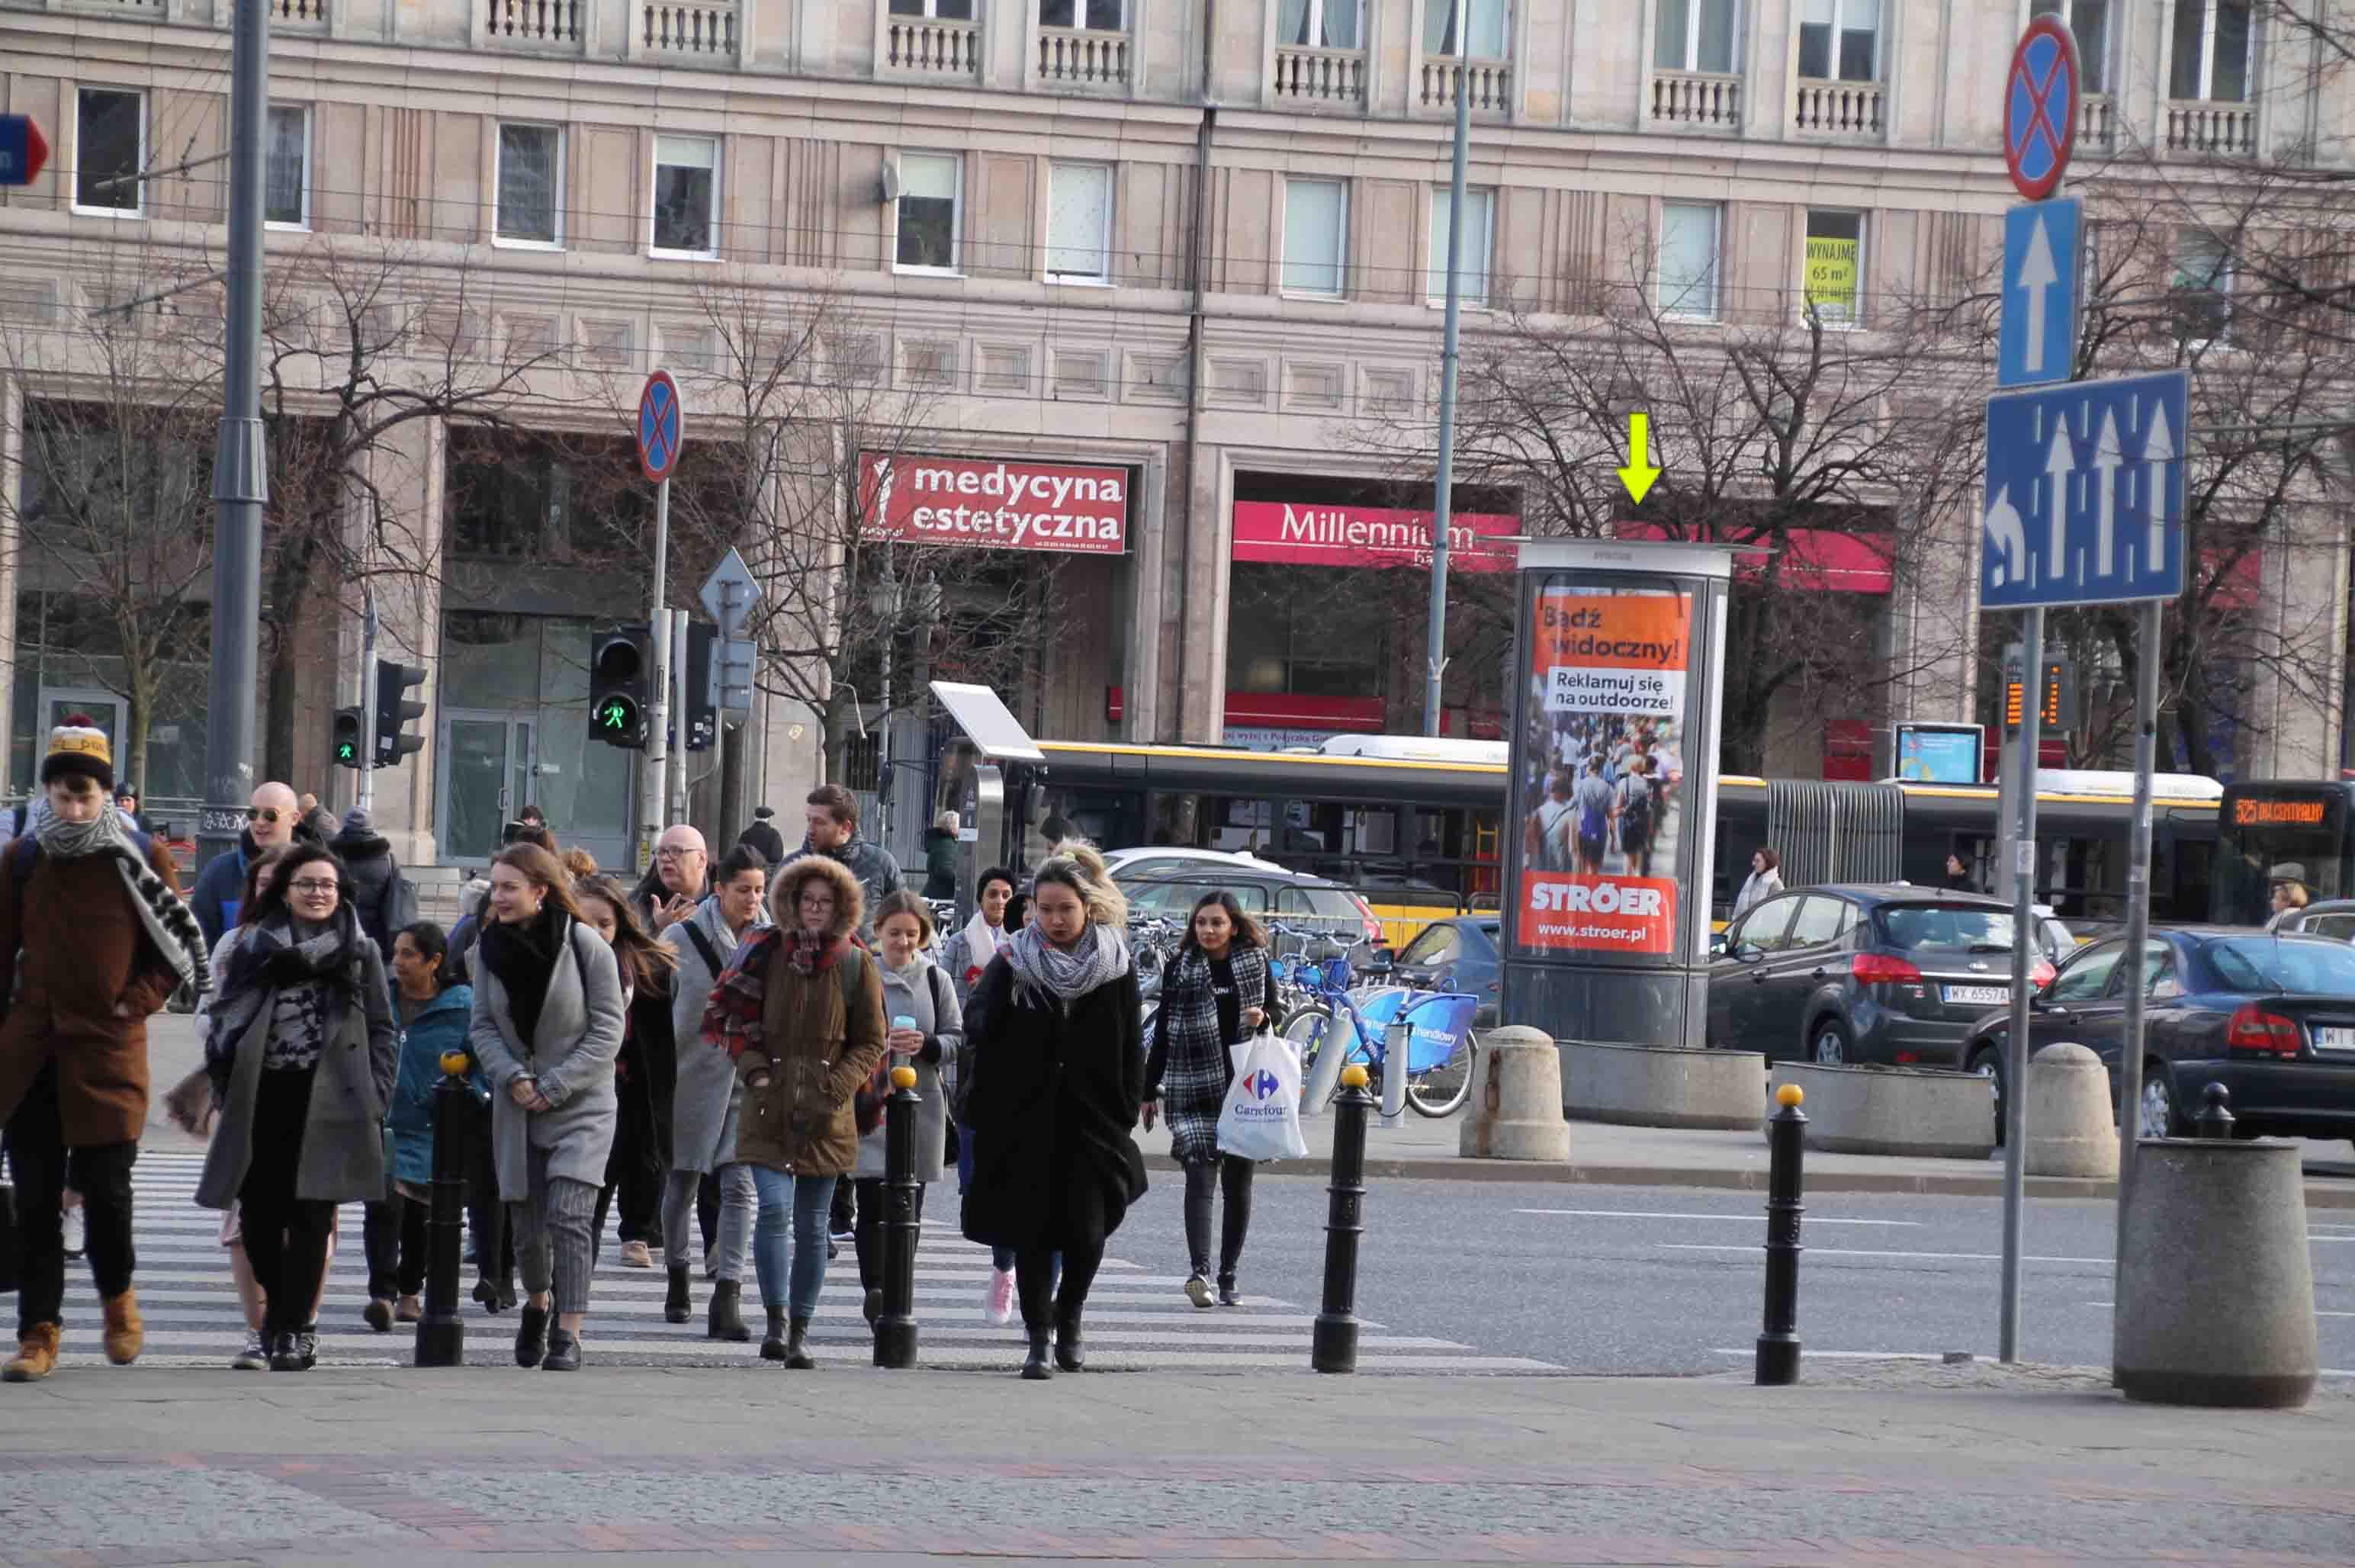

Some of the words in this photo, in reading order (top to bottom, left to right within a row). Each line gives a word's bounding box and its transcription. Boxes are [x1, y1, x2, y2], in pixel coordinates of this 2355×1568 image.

[1813, 266, 1828, 281] 65
[914, 464, 1123, 509] medycyna
[912, 503, 1121, 544] estetyczna
[1543, 605, 1602, 632] Bądź
[1550, 635, 1680, 664] widoczny!
[1556, 672, 1635, 693] Reklamuj
[1638, 676, 1664, 692] się
[1556, 692, 1576, 705] na
[1579, 692, 1674, 710] outdoorze!
[1537, 924, 1647, 942] www.stroer.pl
